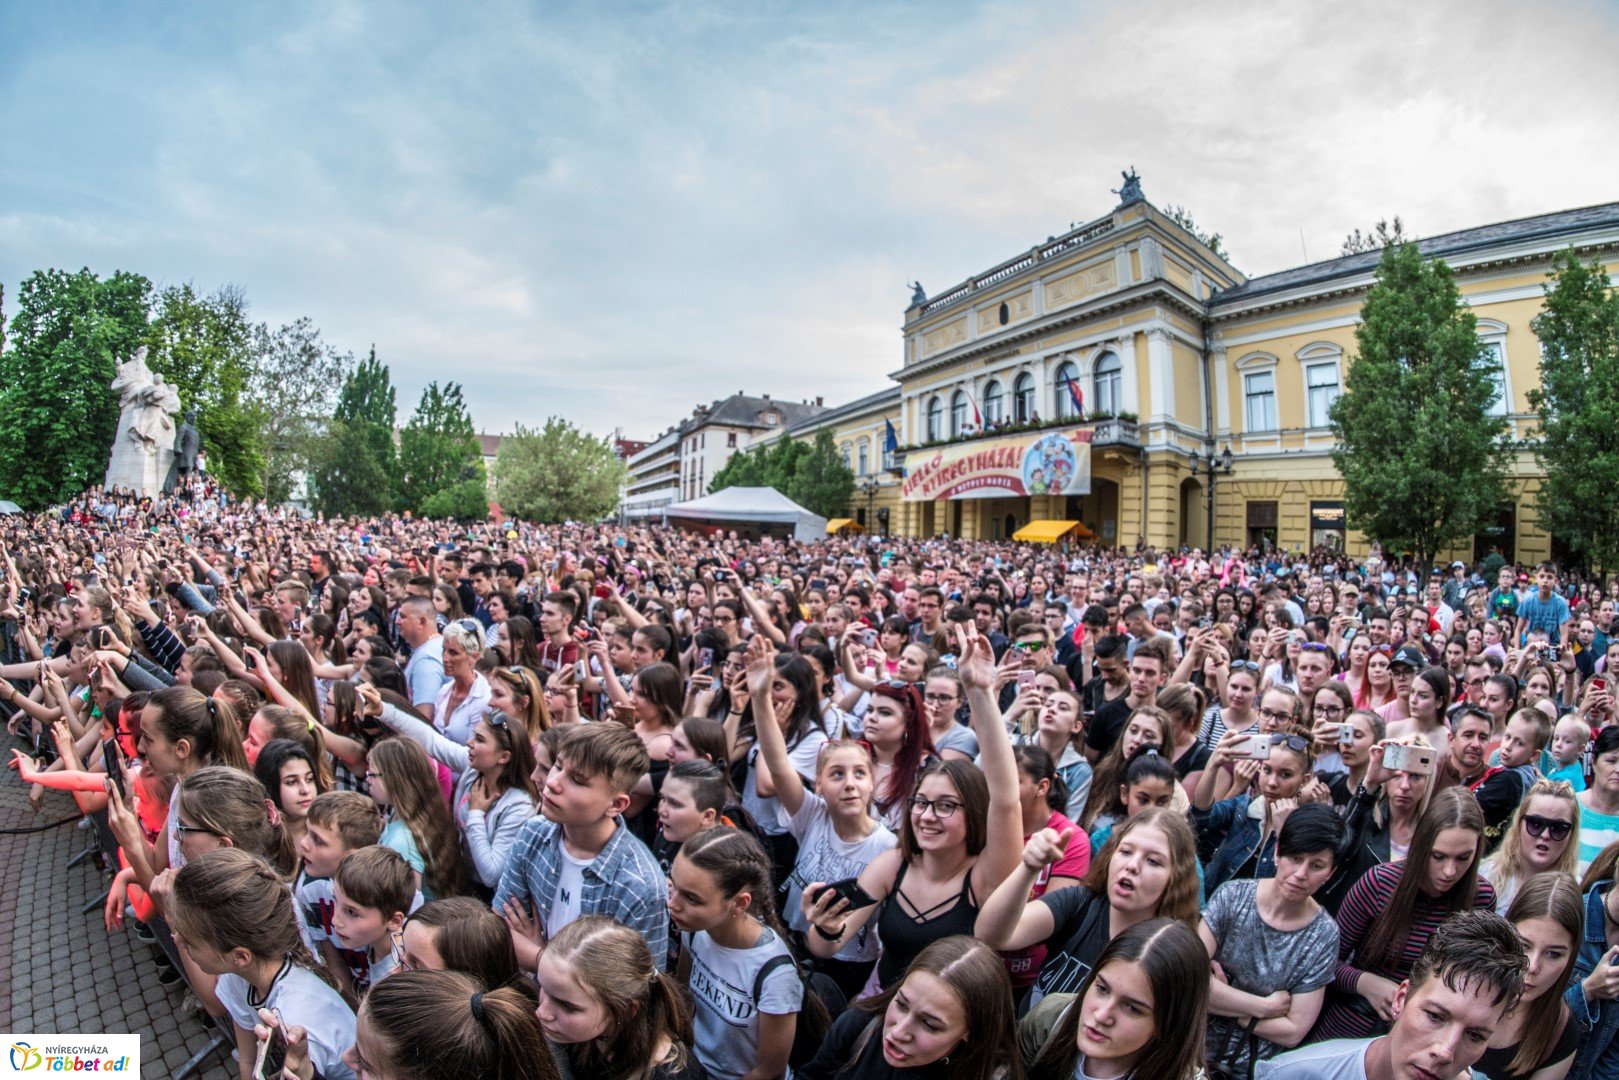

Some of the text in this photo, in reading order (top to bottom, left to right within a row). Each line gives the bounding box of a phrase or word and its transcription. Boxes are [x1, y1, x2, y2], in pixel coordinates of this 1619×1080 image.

[922, 446, 1024, 495] NYÍREGYHÁZA!
[560, 887, 570, 906] M
[691, 964, 753, 1020] EEKEND
